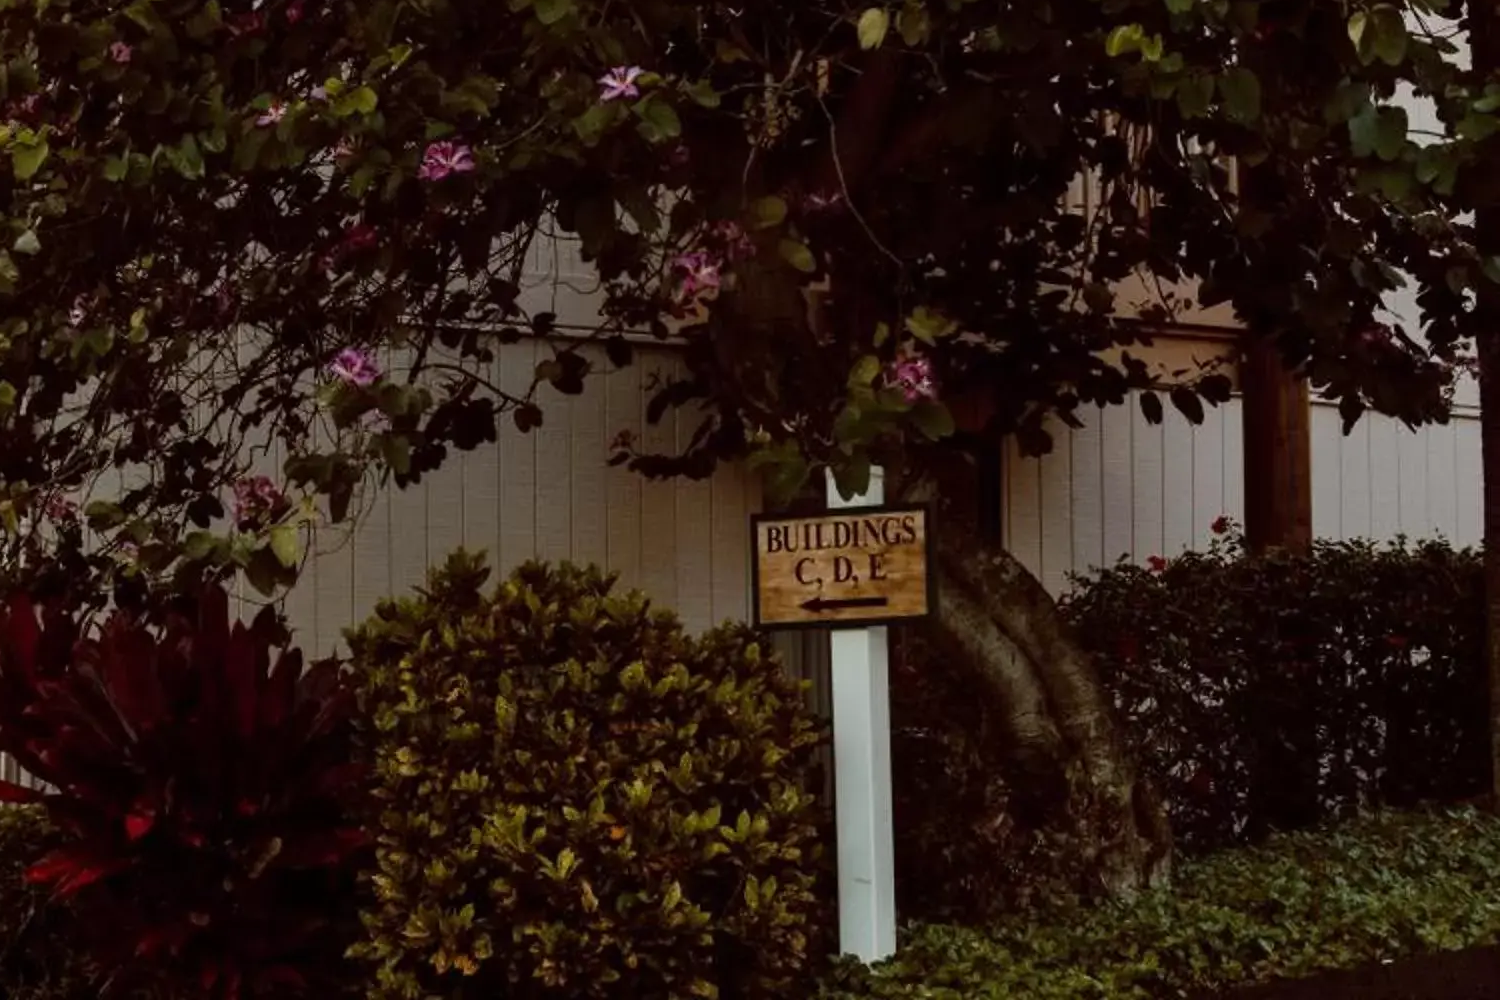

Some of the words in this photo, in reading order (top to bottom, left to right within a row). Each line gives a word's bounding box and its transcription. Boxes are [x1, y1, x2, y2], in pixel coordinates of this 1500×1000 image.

[766, 516, 916, 553] BUILDINGS
[795, 557, 823, 590] C,
[833, 555, 859, 589] D,
[868, 553, 887, 581] E
